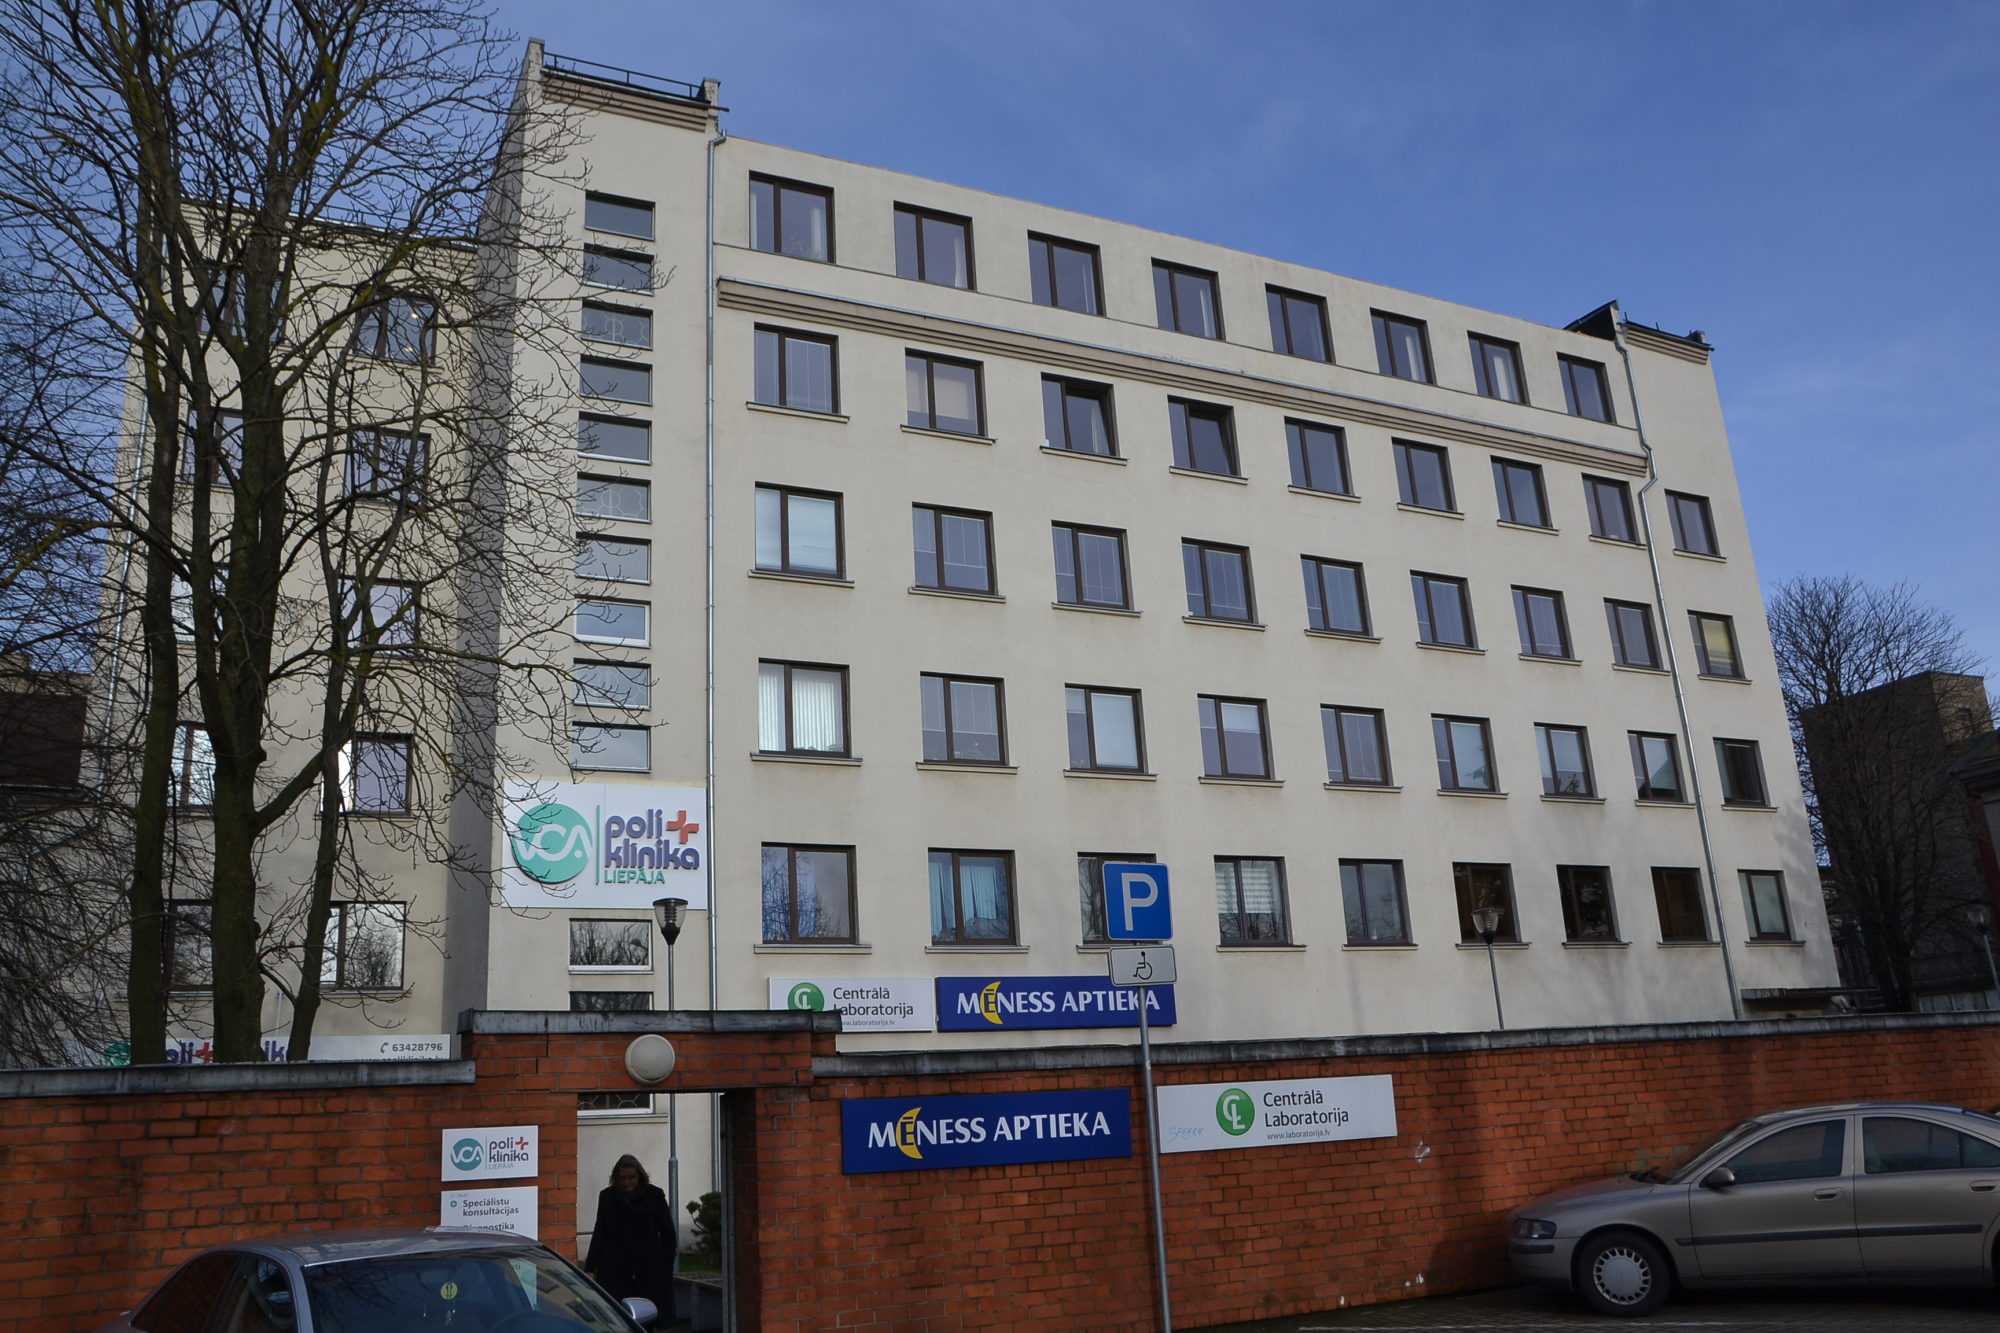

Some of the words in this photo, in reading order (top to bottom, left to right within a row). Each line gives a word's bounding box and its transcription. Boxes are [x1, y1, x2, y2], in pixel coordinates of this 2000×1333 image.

[605, 809, 663, 844] poli
[605, 837, 700, 869] klinika
[604, 867, 665, 884] LIEPĀJA
[1121, 872, 1158, 931] P
[833, 987, 890, 1000] Centrālā
[957, 988, 1055, 1015] MĒNESS
[1062, 990, 1160, 1012] APTIEKA
[392, 1042, 443, 1052] 63428796
[1263, 1090, 1323, 1108] Centrālā
[1264, 1108, 1349, 1128] Laboratorija
[868, 1115, 987, 1148] MĒNESS
[993, 1111, 1111, 1142] APTIEKA
[1267, 1129, 1331, 1140] www.laboratorija.lv
[489, 1137, 514, 1151] poli
[489, 1149, 529, 1163] klinika
[463, 1198, 509, 1208] Speciālistu
[463, 1206, 519, 1217] konsultācijas
